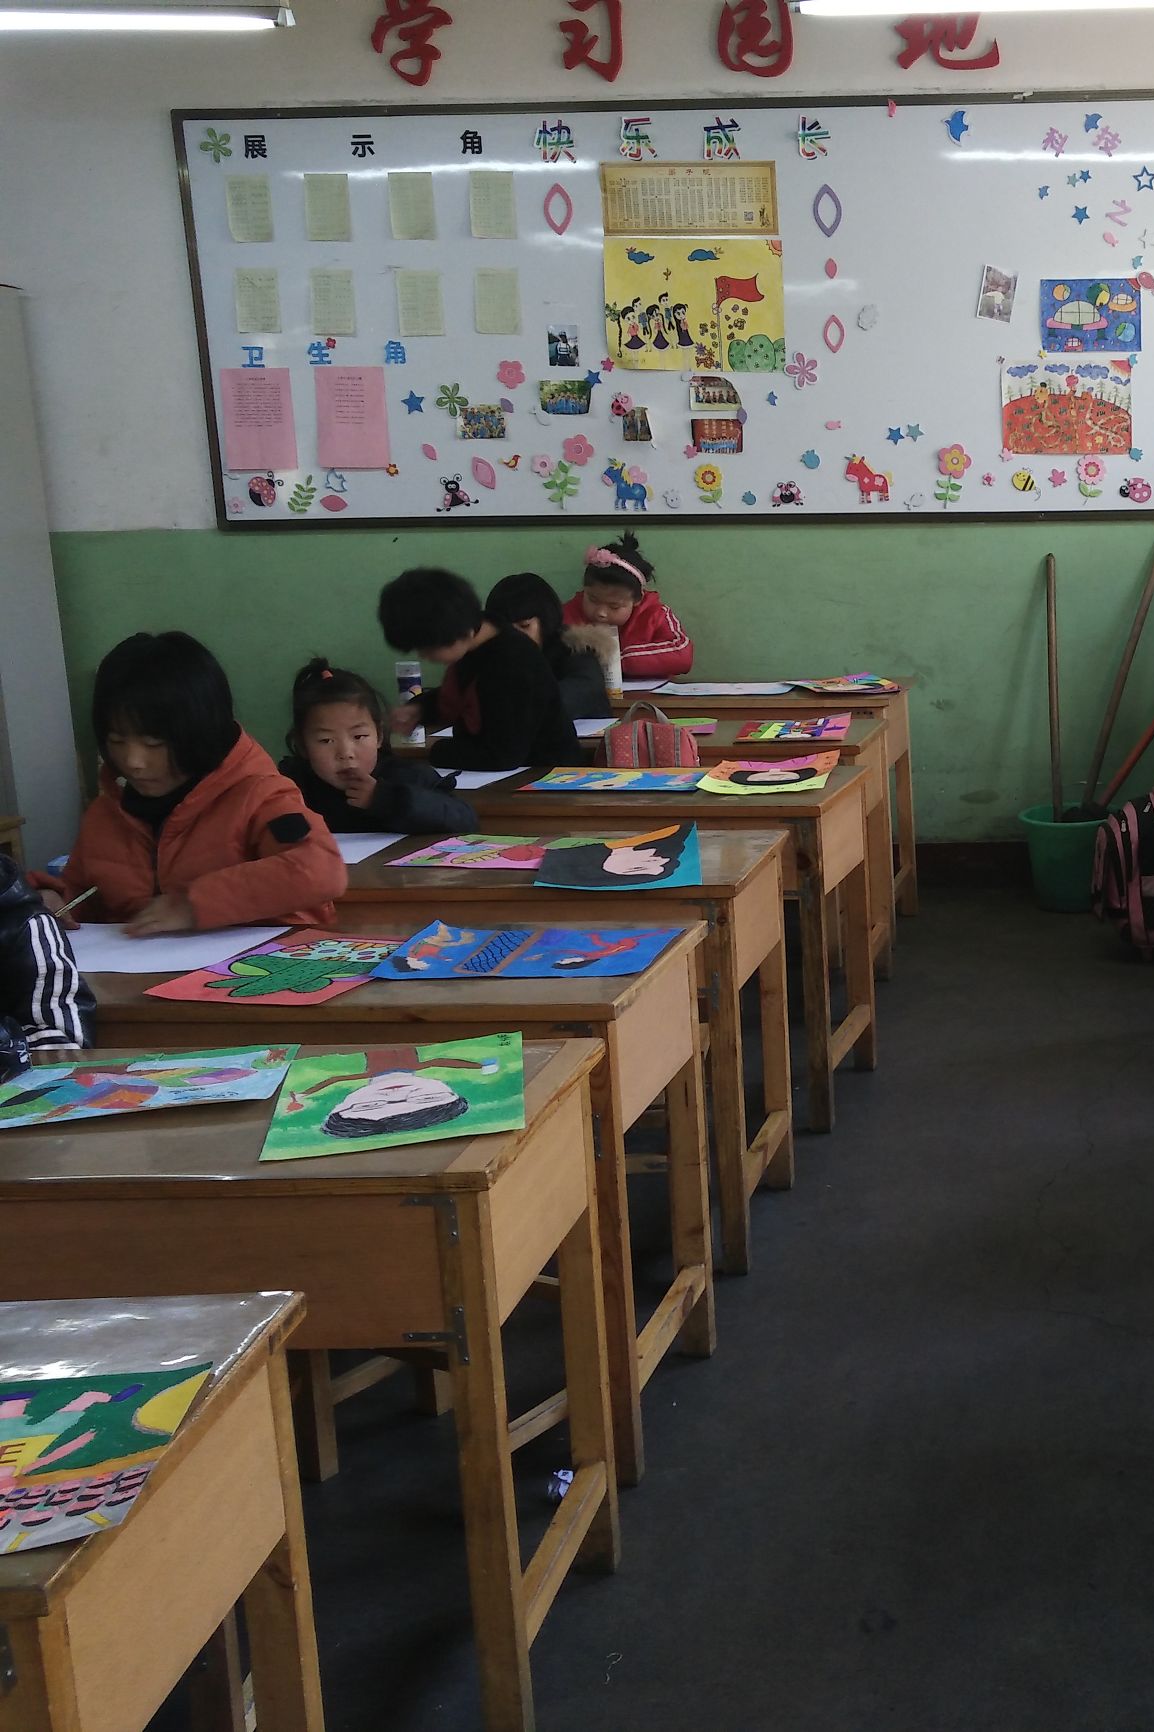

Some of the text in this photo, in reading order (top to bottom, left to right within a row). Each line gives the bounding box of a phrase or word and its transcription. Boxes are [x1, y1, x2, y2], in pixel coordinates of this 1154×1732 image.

[370, 0, 1001, 87] 学习园地
[244, 130, 483, 159] 展示角
[534, 114, 831, 163] 快乐成长
[241, 339, 407, 368] 卫生角
